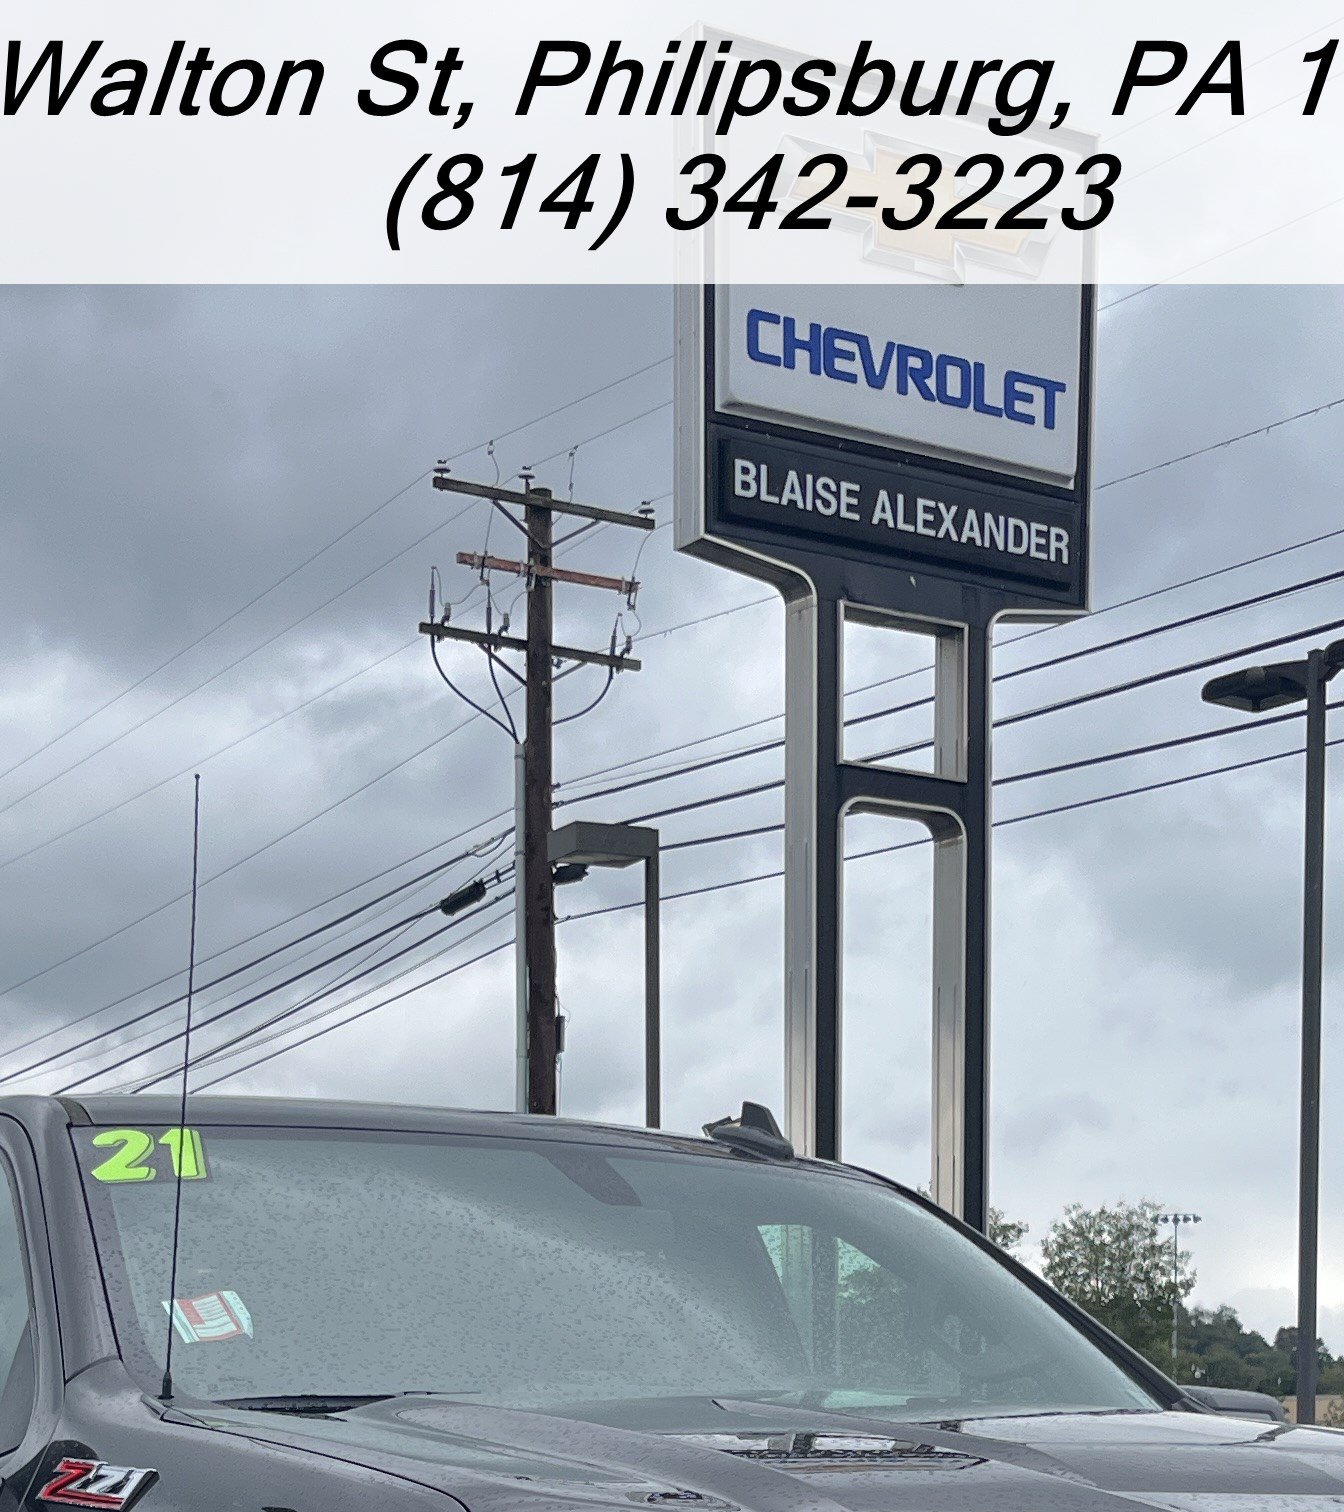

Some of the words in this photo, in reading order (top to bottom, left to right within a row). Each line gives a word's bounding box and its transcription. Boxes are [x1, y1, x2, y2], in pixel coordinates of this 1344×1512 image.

[747, 308, 1066, 429] CHEVROLET
[734, 458, 861, 522] BLAISE
[871, 489, 1070, 565] ALEXANDER
[91, 1128, 207, 1183] 21
